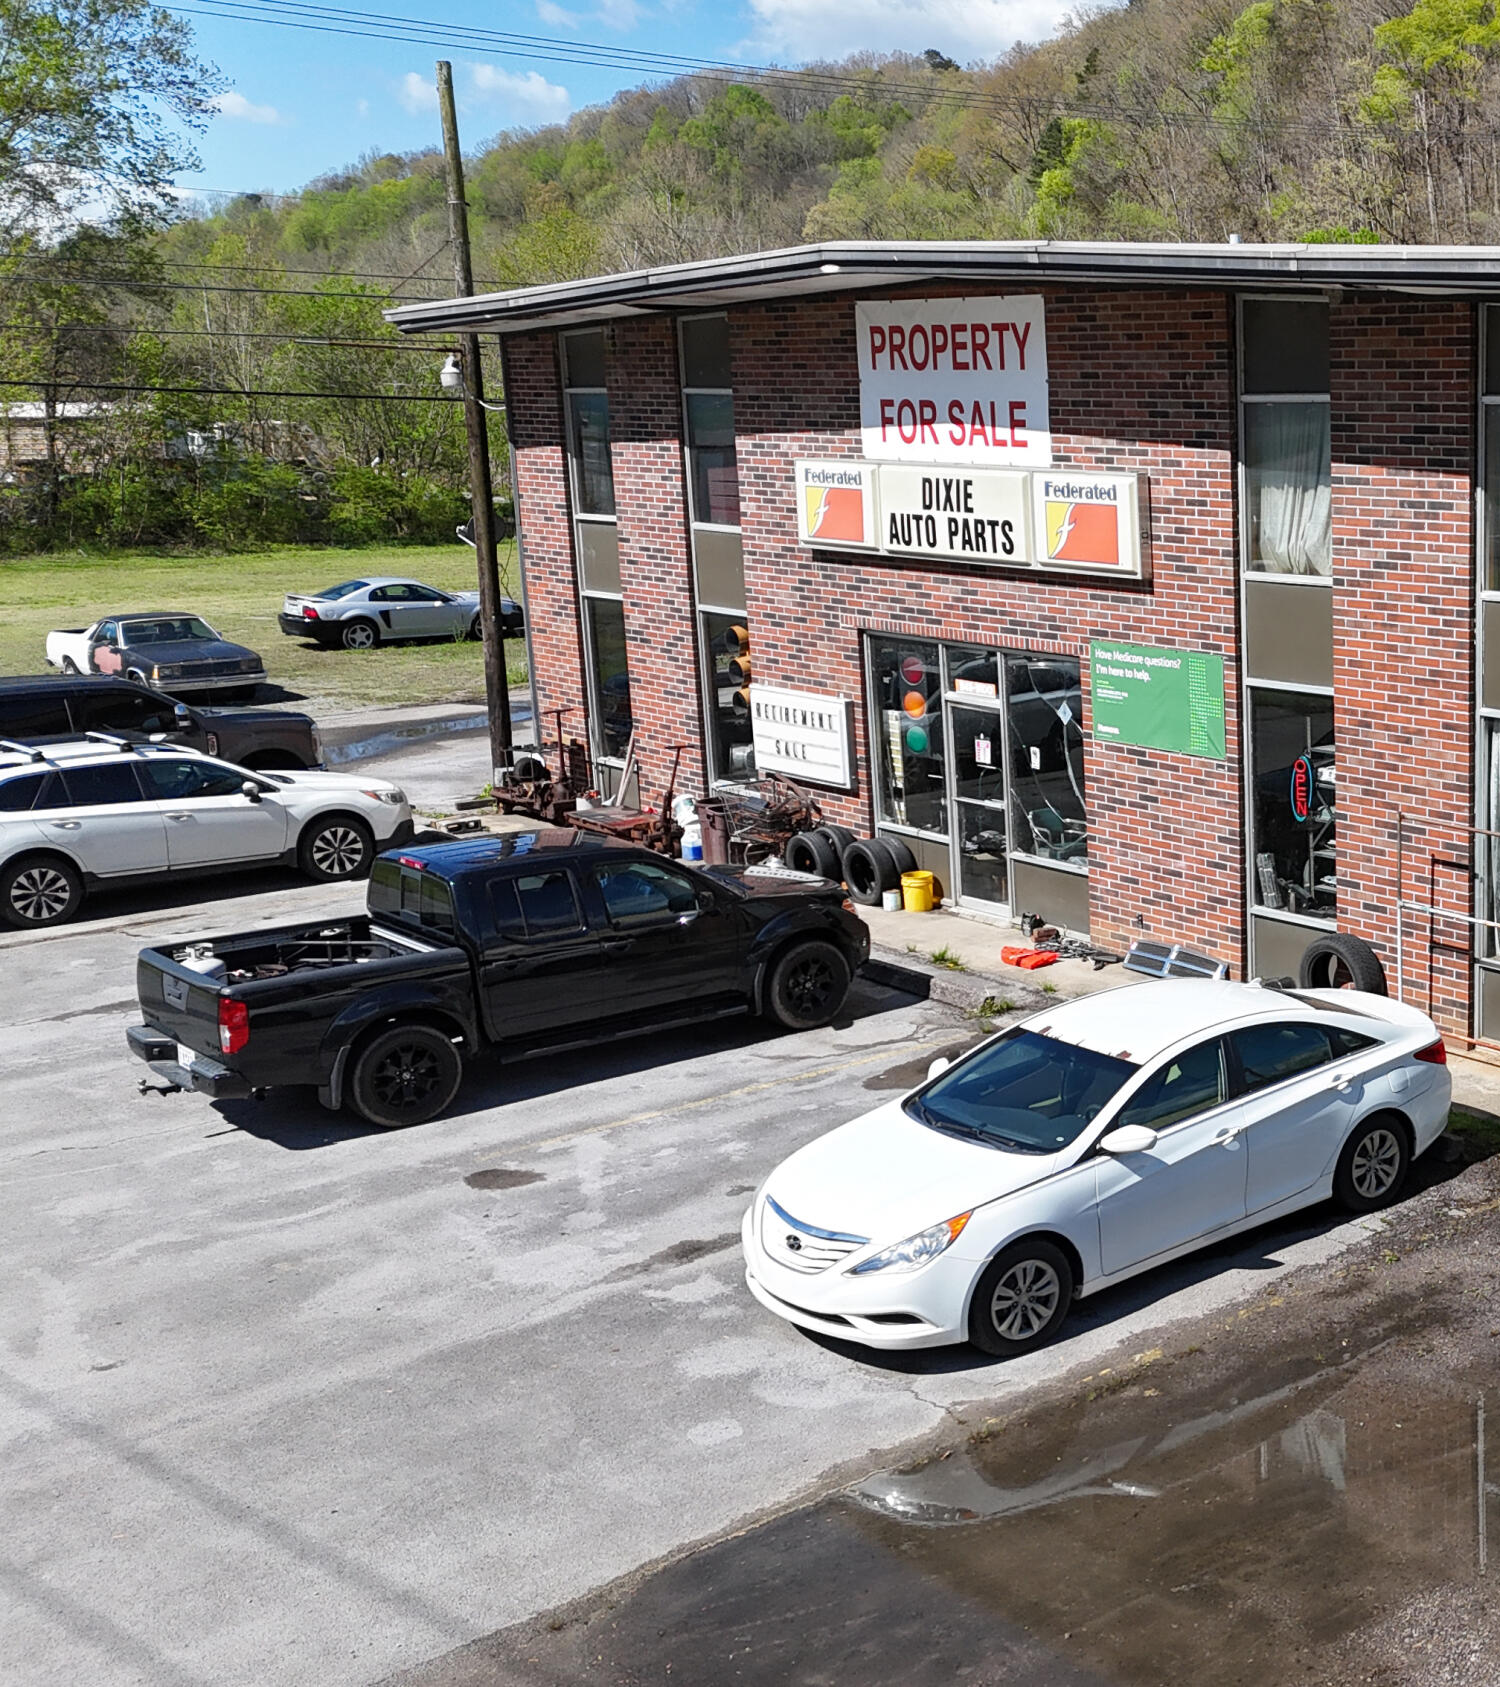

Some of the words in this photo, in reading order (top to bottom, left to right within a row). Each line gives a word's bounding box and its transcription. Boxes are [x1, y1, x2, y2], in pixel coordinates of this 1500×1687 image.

[869, 322, 1031, 371] PROPERTY
[879, 398, 939, 444] FOR
[948, 400, 1029, 448] SALE
[804, 467, 862, 486] Federated
[1044, 480, 1117, 501] Federated
[921, 477, 974, 514] DIXIE
[889, 513, 937, 548] AUTO
[948, 517, 1015, 555] PARTS
[1095, 649, 1112, 660] Have
[1113, 650, 1143, 664] Medicare
[1144, 656, 1181, 669] questions?
[1108, 665, 1124, 677] here
[1125, 668, 1133, 678] to
[756, 702, 832, 730] RETIREMENT
[775, 739, 807, 760] SALE
[1294, 759, 1307, 817] OPEN
